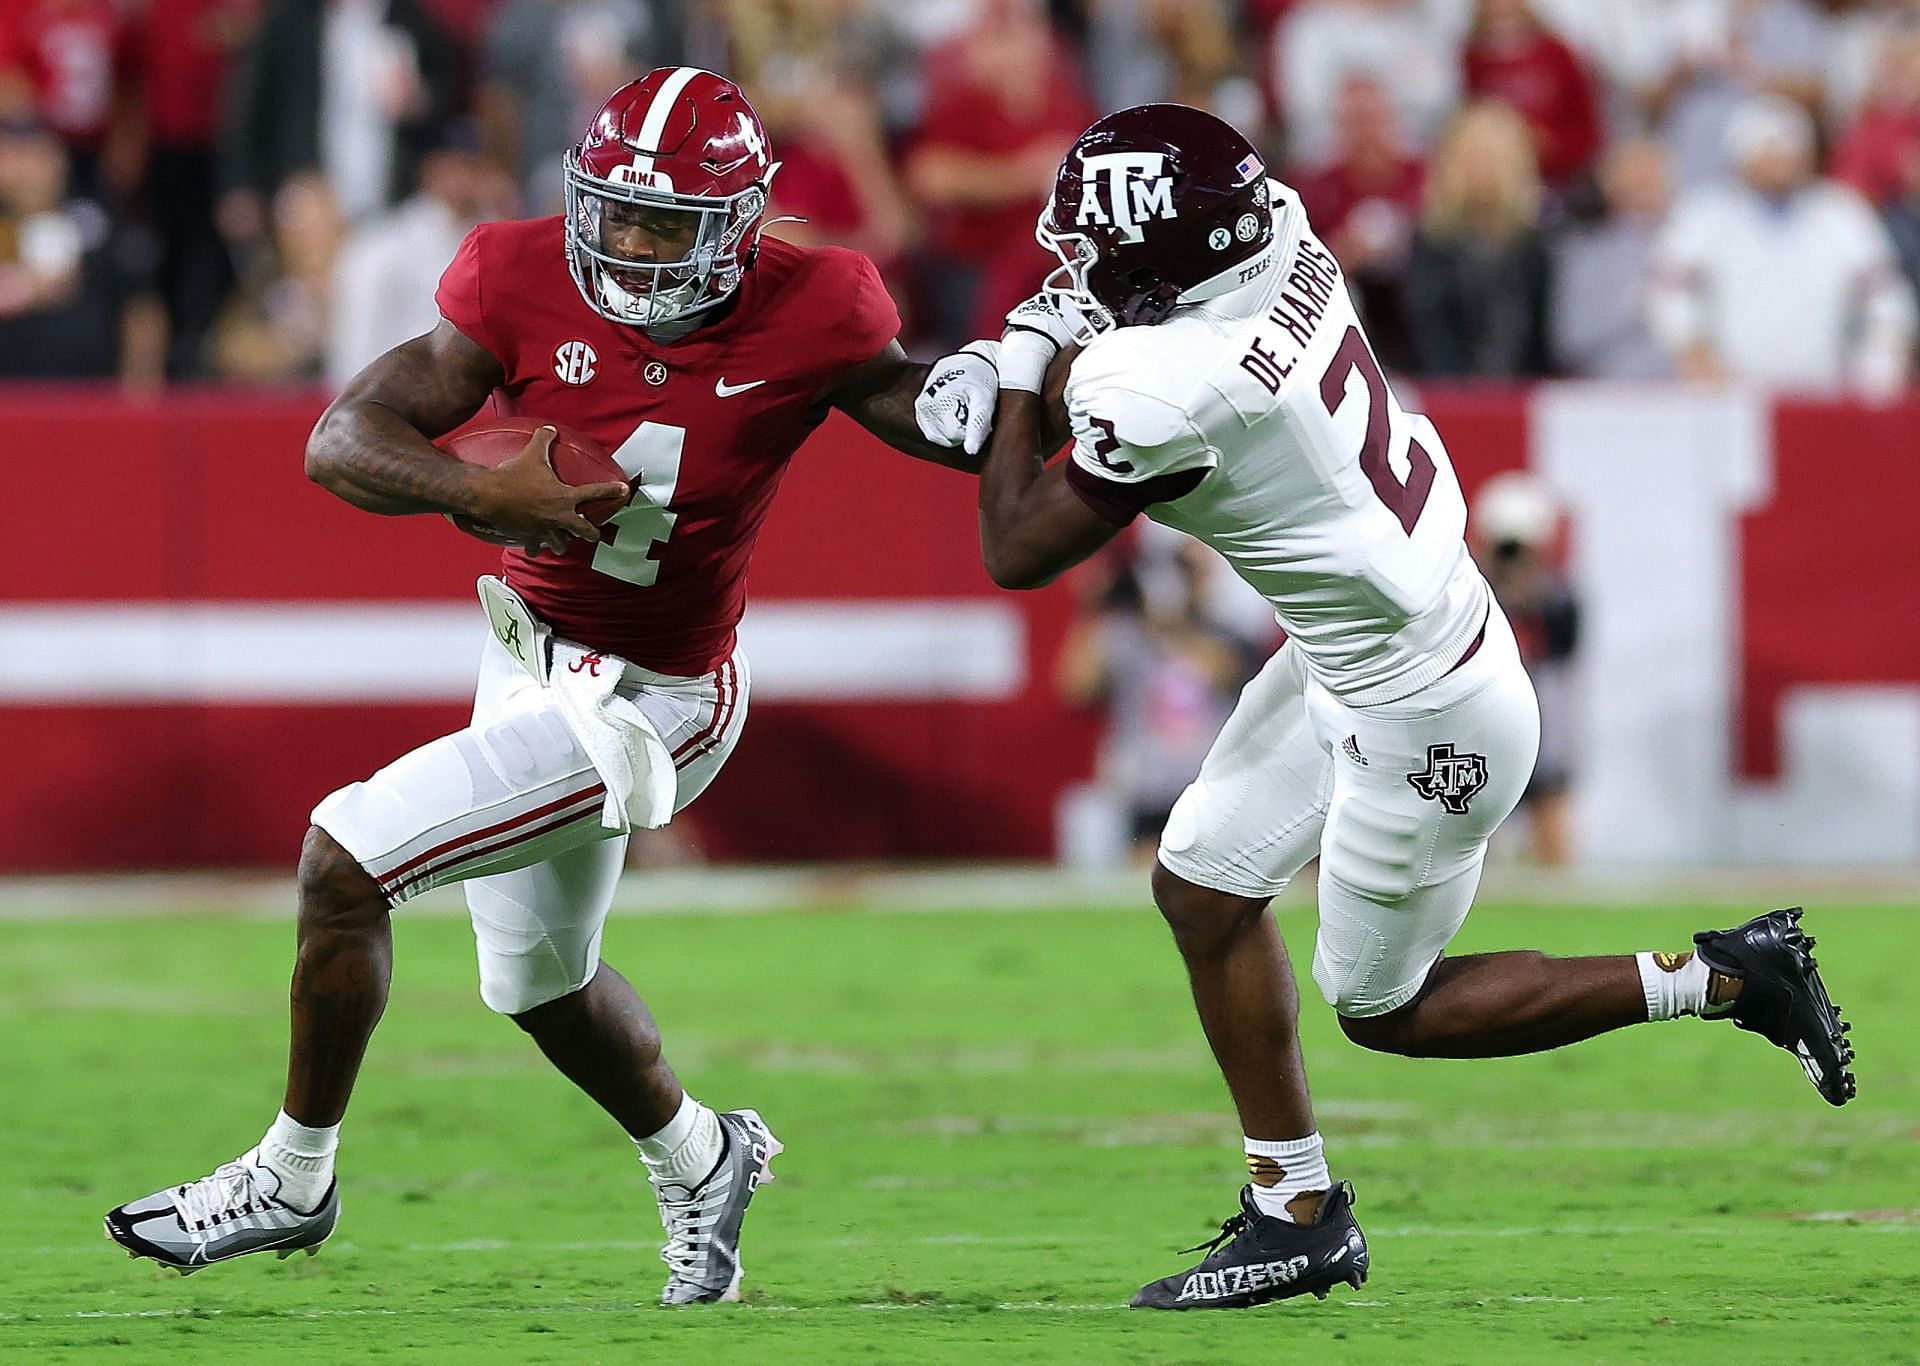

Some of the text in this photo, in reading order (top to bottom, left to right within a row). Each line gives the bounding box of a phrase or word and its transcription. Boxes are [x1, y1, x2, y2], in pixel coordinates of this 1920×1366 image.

[622, 169, 656, 187] BAMA
[1240, 240, 1338, 396] DE. HARRIS
[554, 341, 599, 385] SEC
[1089, 416, 1135, 474] 2
[1319, 325, 1437, 537] 2
[591, 420, 686, 587] 4
[1174, 1254, 1308, 1302] ADIZERO
